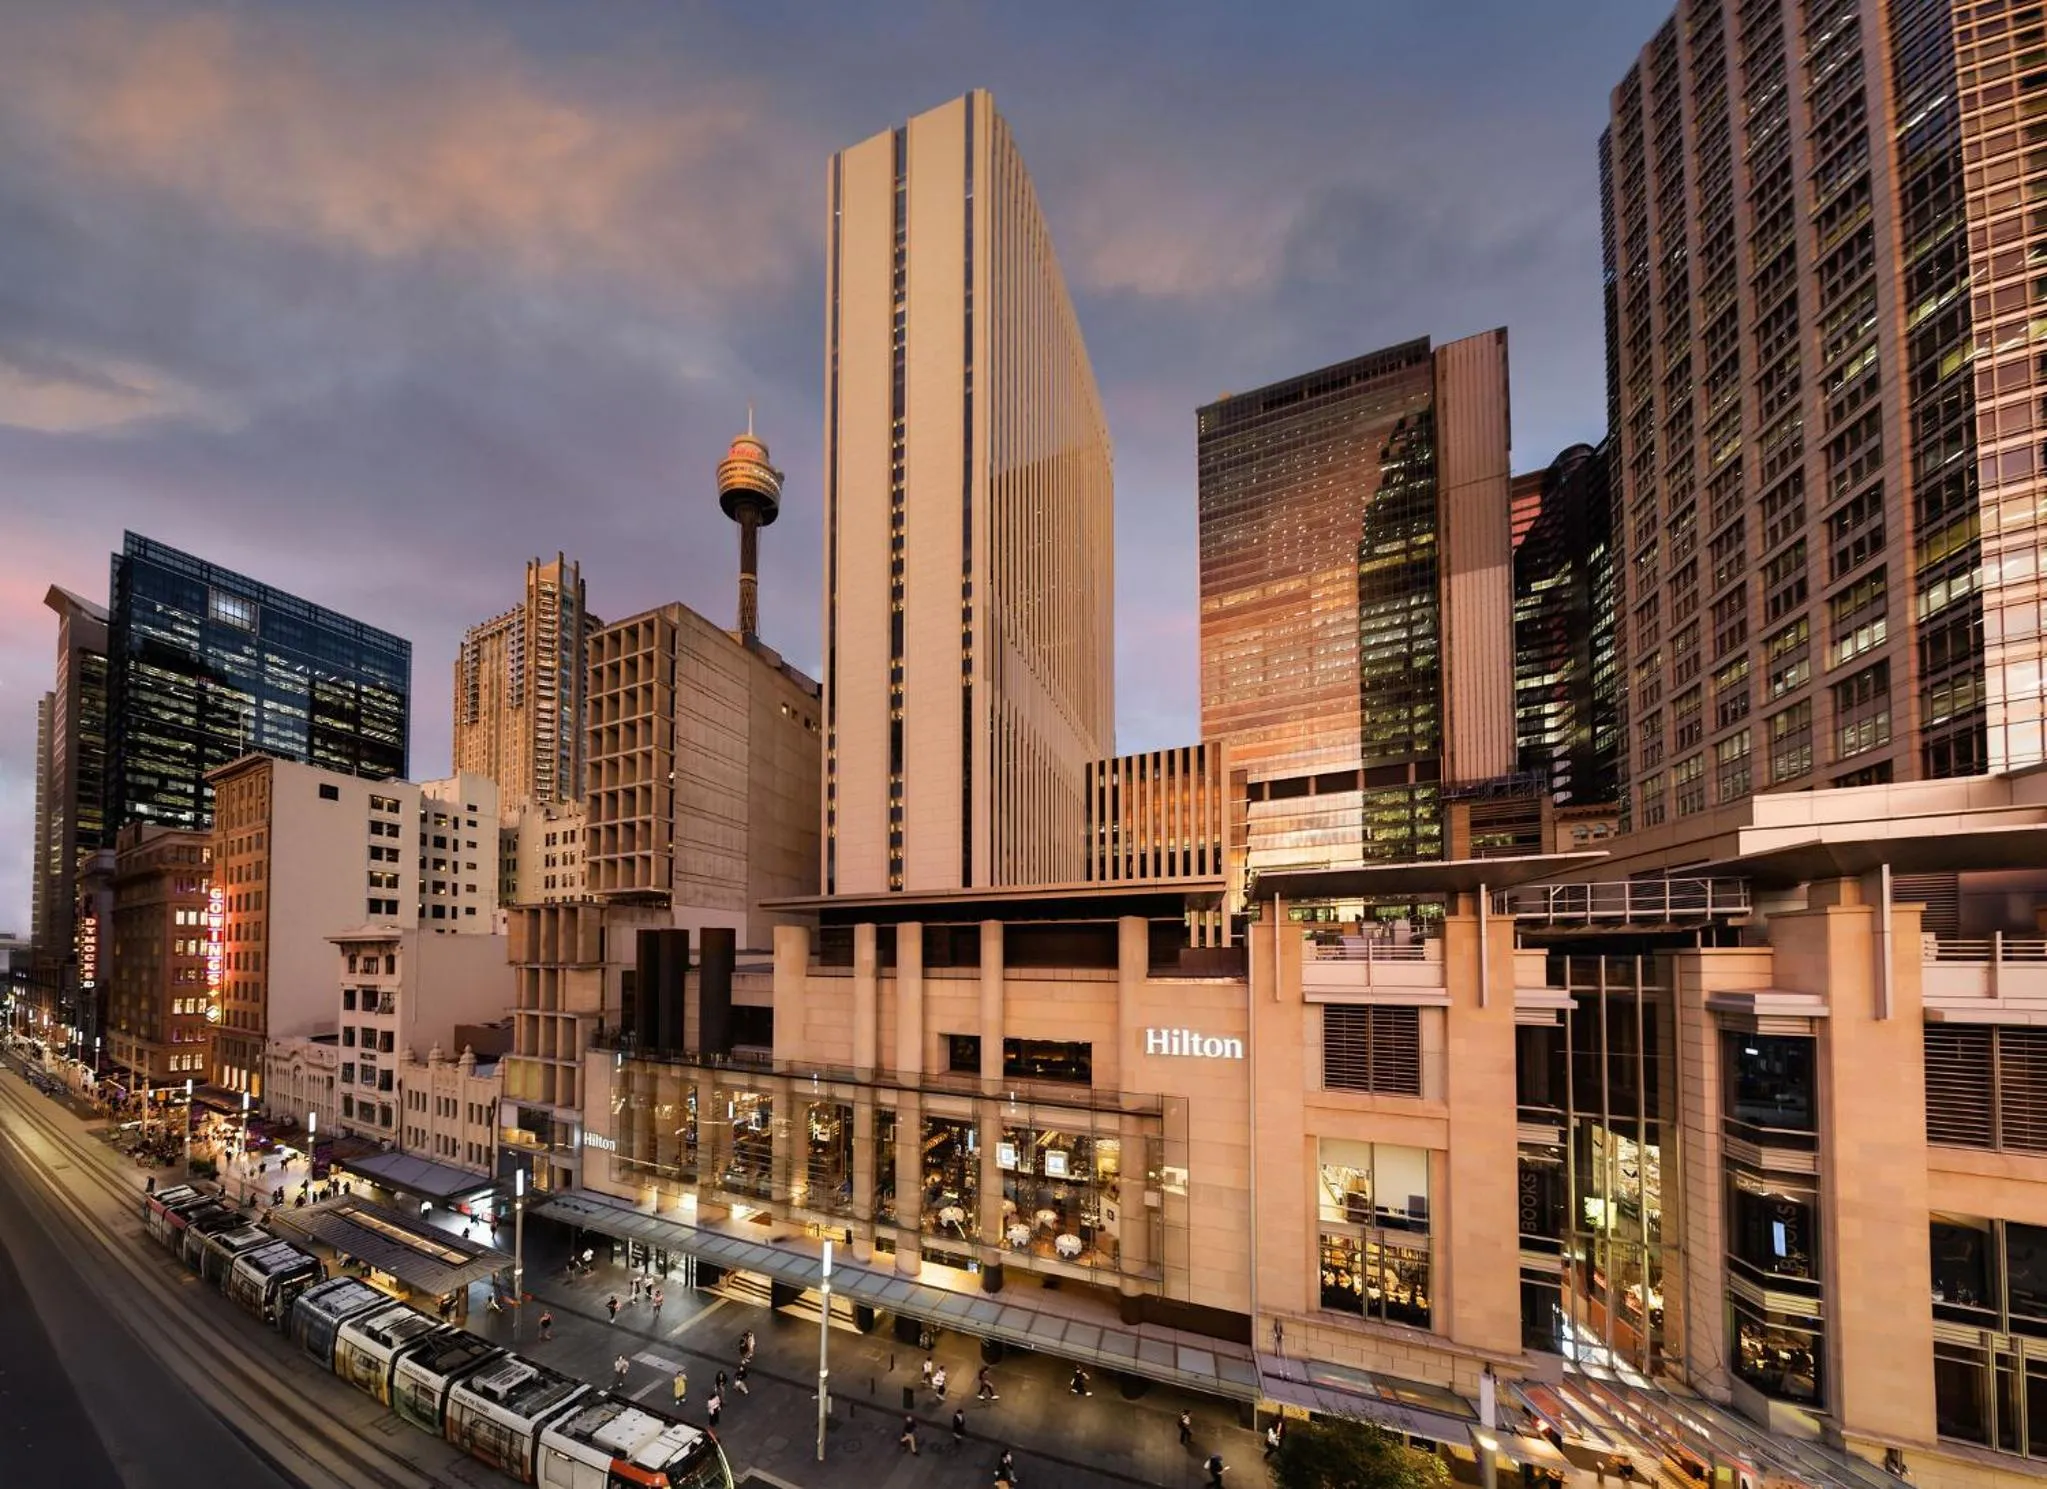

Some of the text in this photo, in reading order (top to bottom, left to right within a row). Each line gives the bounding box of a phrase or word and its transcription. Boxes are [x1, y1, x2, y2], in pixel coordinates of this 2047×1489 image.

[207, 887, 223, 985] GOWINGS
[1145, 1028, 1244, 1059] Hilton
[584, 1131, 616, 1151] Hilton
[1521, 1173, 1537, 1232] BOOKS
